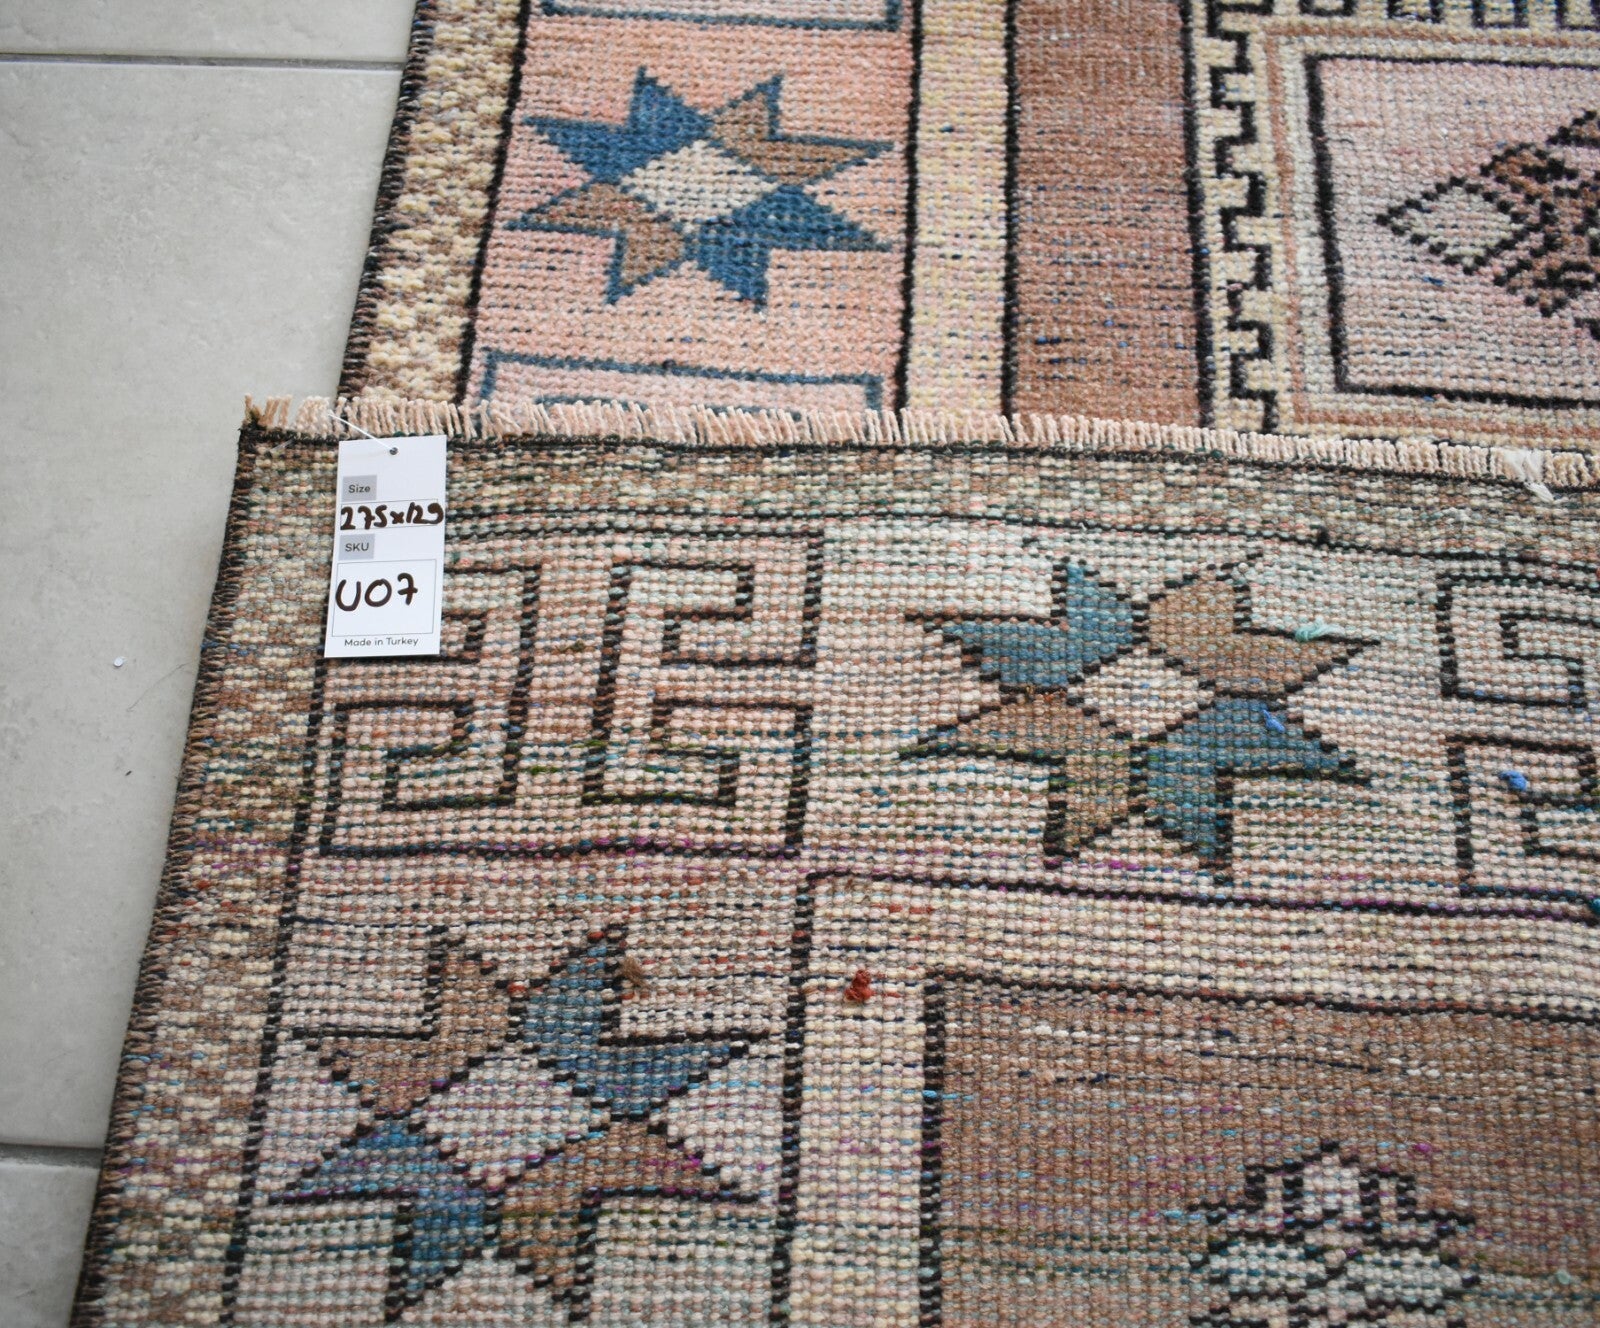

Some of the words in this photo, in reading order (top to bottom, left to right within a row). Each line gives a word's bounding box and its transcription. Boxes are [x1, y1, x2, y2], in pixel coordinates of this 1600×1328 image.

[348, 484, 371, 493] Size
[340, 502, 444, 530] 275x129
[345, 542, 369, 552] SKU
[344, 638, 372, 647] Made
[374, 637, 384, 646] in
[386, 637, 419, 646] Turkey
